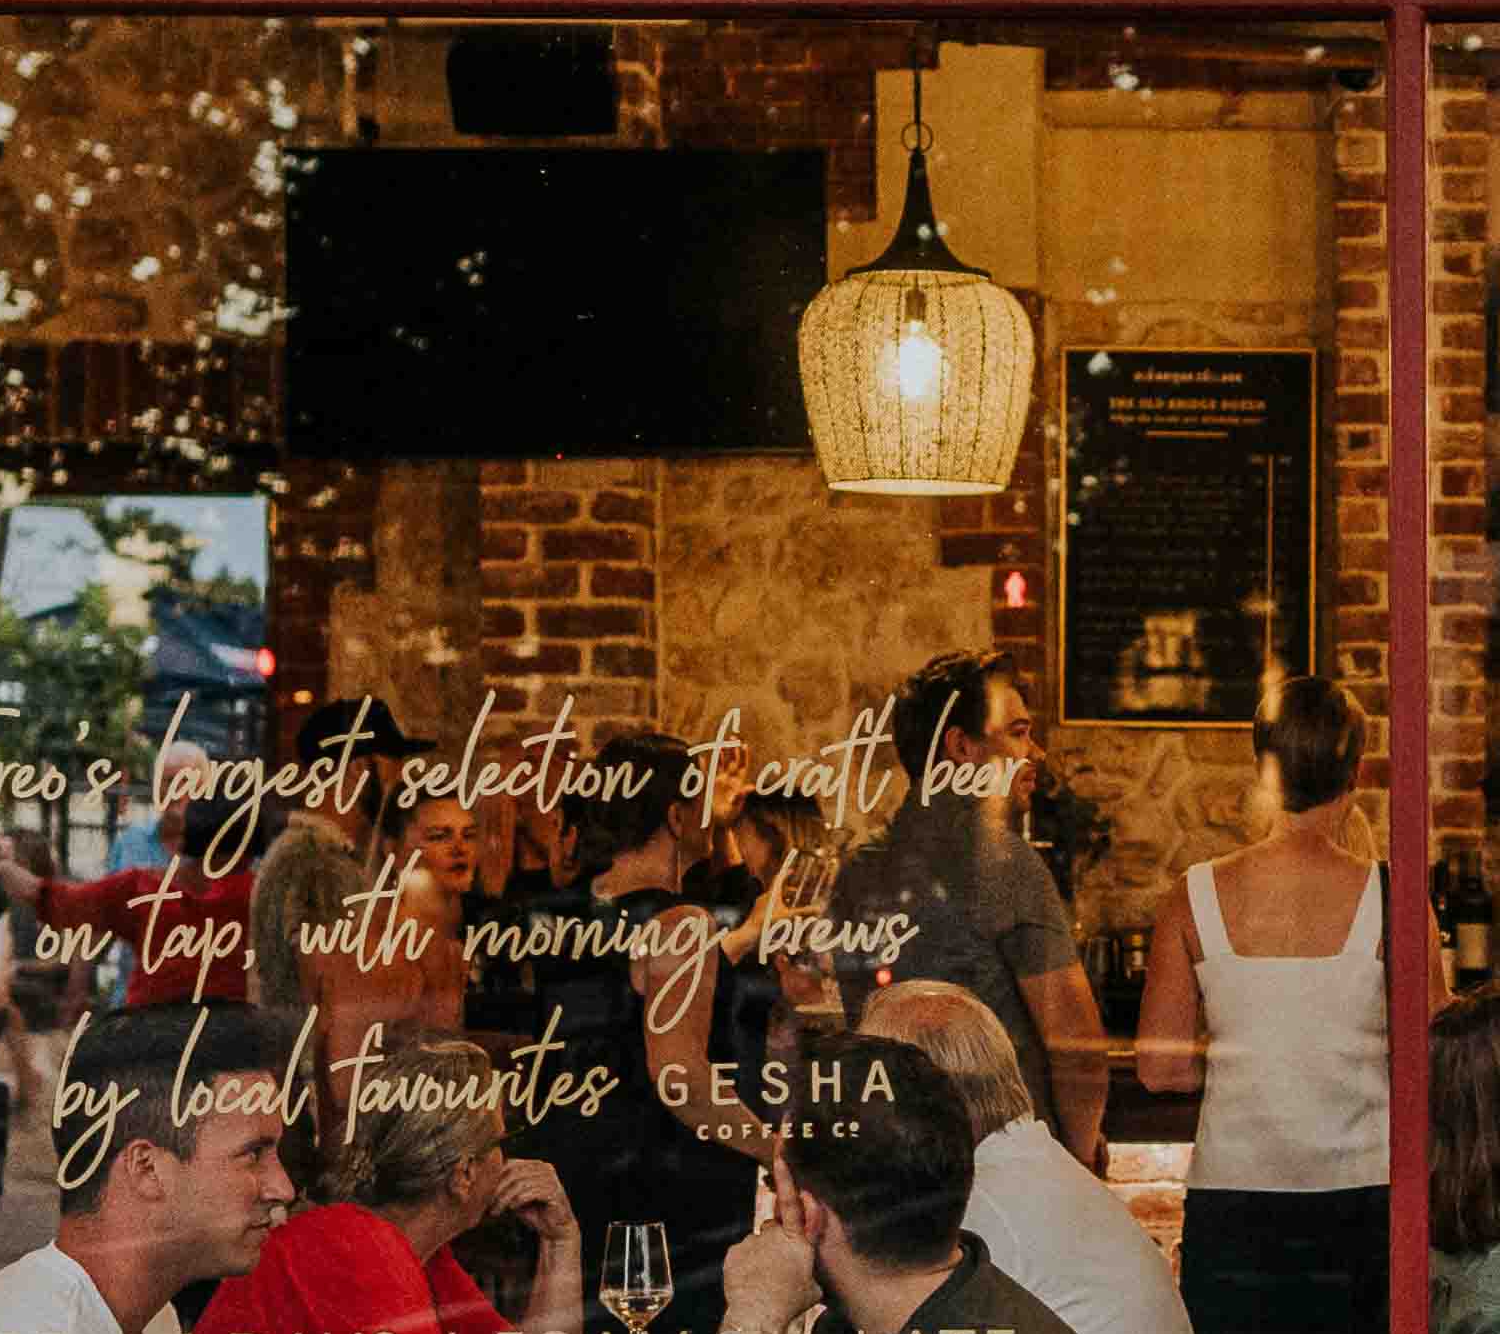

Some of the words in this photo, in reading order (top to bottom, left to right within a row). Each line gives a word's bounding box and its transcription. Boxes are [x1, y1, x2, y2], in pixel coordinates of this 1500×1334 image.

[150, 693, 374, 879] largest
[397, 689, 654, 811] selection
[680, 707, 746, 828] of
[755, 693, 897, 830] craft
[918, 689, 1031, 812] beer
[35, 920, 112, 964] on
[127, 854, 258, 1004] tap,
[299, 849, 436, 971] with
[462, 907, 731, 1035] morning
[756, 847, 920, 965] brews
[52, 1010, 140, 1191] by
[171, 1007, 318, 1128] local
[330, 1005, 620, 1144] favourites
[657, 1059, 895, 1107] GESHA
[696, 1123, 815, 1140] COFFEE
